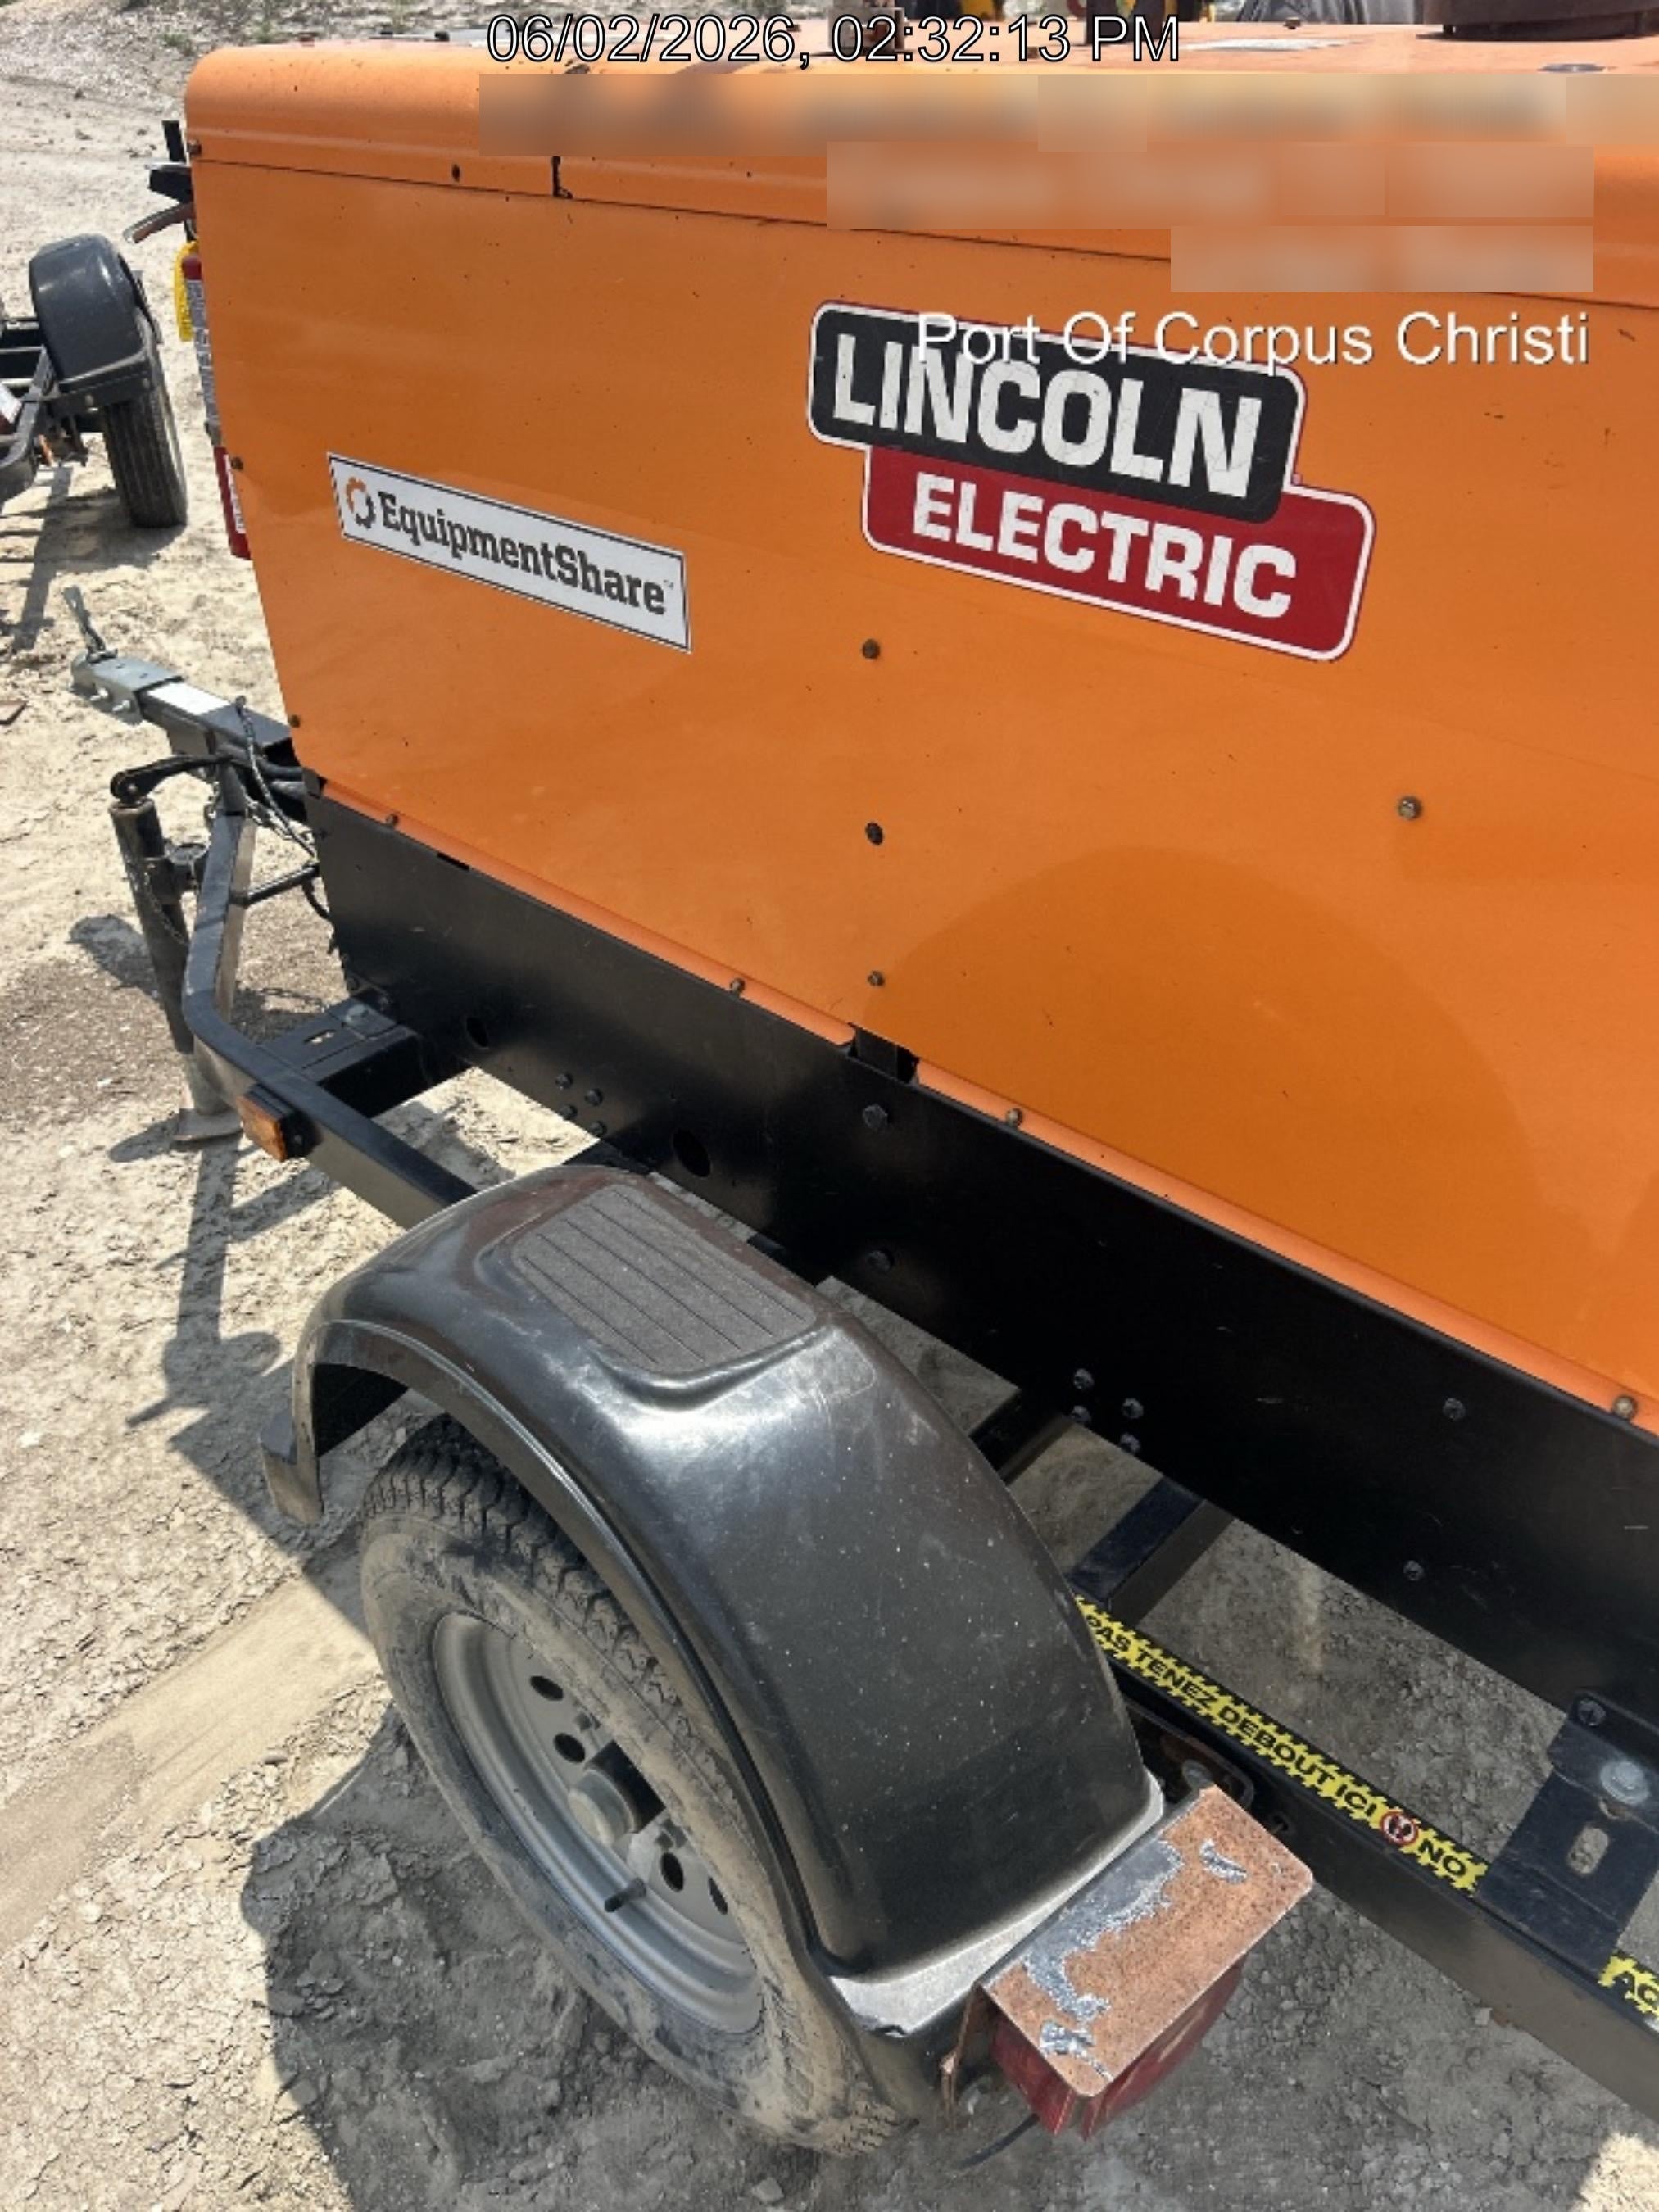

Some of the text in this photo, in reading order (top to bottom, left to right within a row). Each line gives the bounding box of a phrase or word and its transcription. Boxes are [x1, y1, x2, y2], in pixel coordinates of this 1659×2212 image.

[832, 333, 1262, 499] LINCOLN
[377, 491, 666, 614] EquipmentShare
[912, 470, 1298, 619] ELECTRIC
[1135, 1647, 1218, 1708] TENEZ
[1218, 1704, 1335, 1784] DEBOUT
[1335, 1784, 1378, 1817] ICI
[1417, 1838, 1468, 1877] NO
